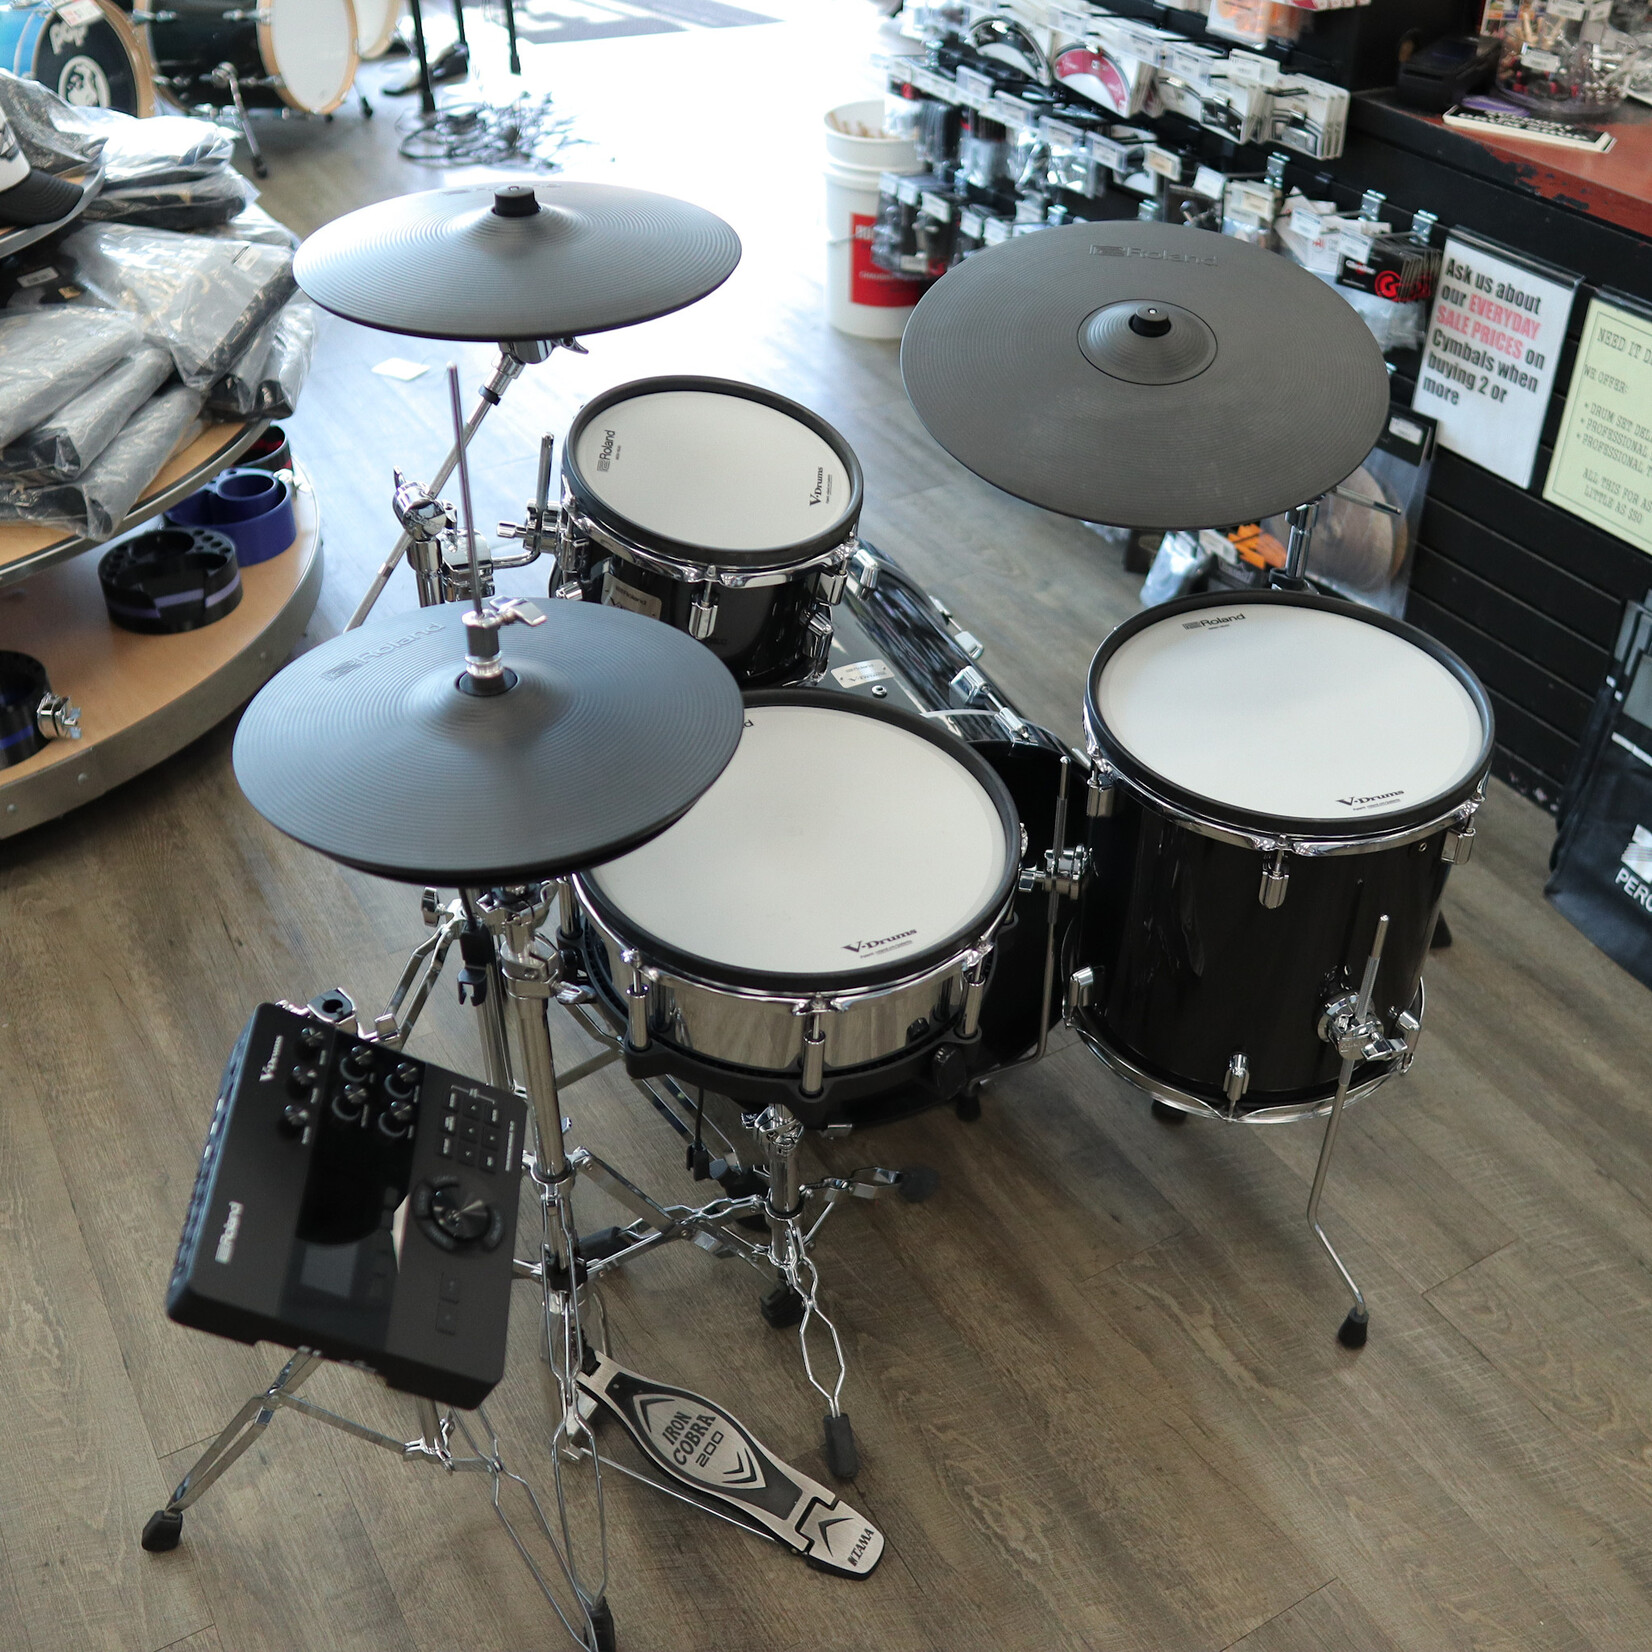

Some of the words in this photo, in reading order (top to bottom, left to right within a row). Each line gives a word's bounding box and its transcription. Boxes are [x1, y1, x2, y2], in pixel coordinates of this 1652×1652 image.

[1126, 246, 1219, 267] Roland
[1445, 258, 1472, 283] Ask
[1475, 273, 1494, 294] us
[1496, 282, 1542, 315] about
[1441, 285, 1467, 308] our
[1468, 294, 1542, 341] EVERYDAY
[1436, 305, 1471, 335] SALE
[1471, 320, 1524, 360] PRICES
[1525, 349, 1546, 371] on
[1597, 327, 1626, 352] NEED
[1628, 342, 1642, 359] IT
[1427, 351, 1477, 391] buying
[1479, 376, 1489, 395] 2
[1490, 385, 1508, 403] or
[1432, 327, 1495, 372] Cymbals
[1498, 359, 1539, 394] when
[1583, 364, 1597, 379] WE
[1422, 376, 1460, 405] more
[1590, 402, 1614, 423] DRUM
[1616, 415, 1634, 433] SET
[598, 429, 616, 461] Roland
[1582, 433, 1644, 474] PROFESSIONAL
[1586, 418, 1648, 458] PROFESSIONAL
[809, 466, 823, 506] V-Drums
[1582, 468, 1599, 484] ALL
[1601, 476, 1621, 496] THIS
[1622, 487, 1640, 506] FOR
[1584, 484, 1614, 509] LITTLE
[1615, 502, 1628, 516] AS
[1200, 613, 1246, 627] Roland
[357, 622, 446, 664] Roland
[1336, 790, 1405, 806] V-Drums
[842, 929, 918, 952] V-Drums
[219, 1200, 245, 1247] Roland
[662, 1411, 692, 1445] IRON
[673, 1414, 716, 1465] COBRA
[695, 1430, 725, 1468] 200
[850, 1527, 875, 1560] TAMA
